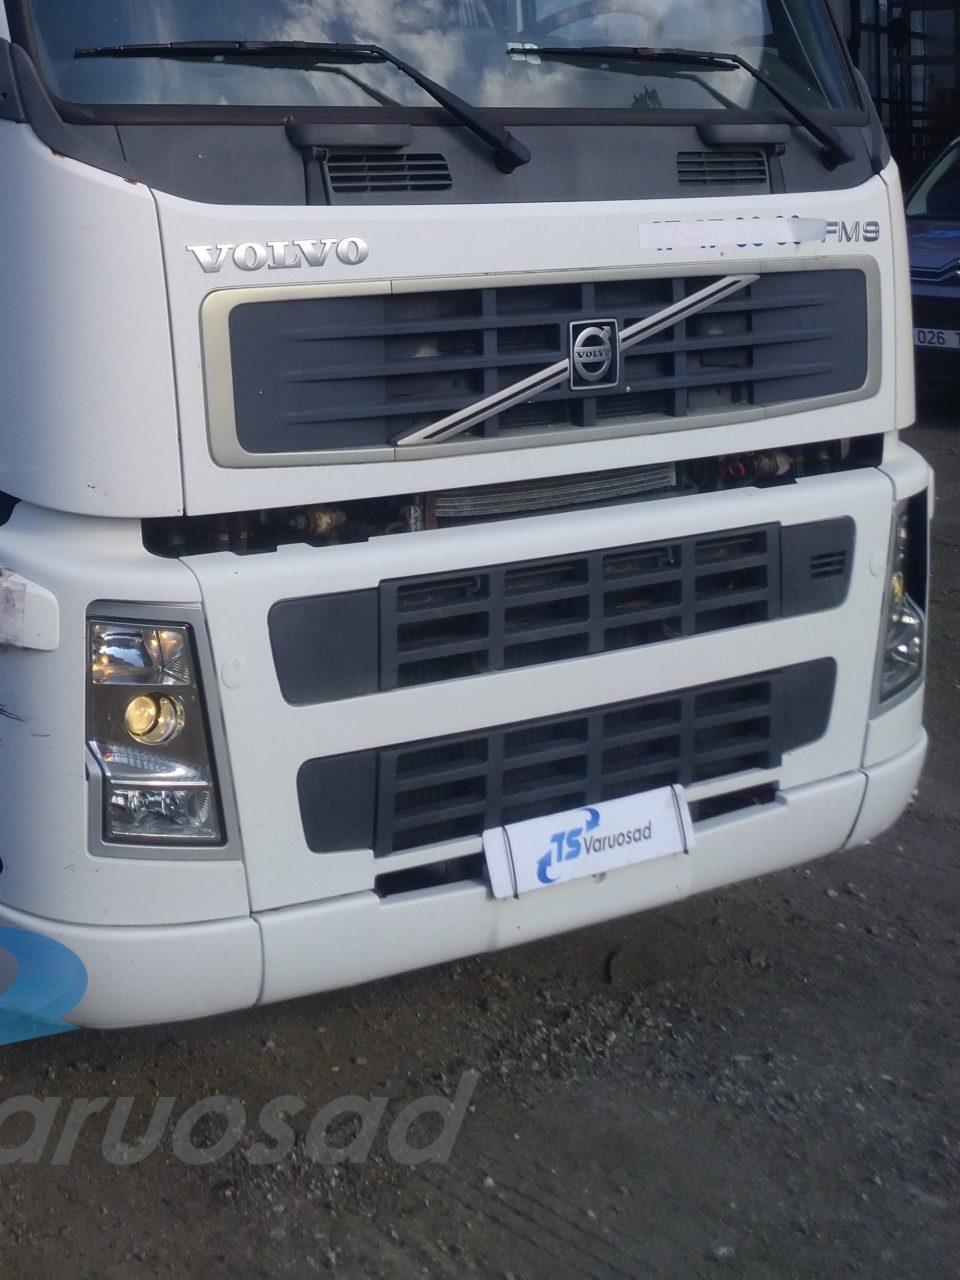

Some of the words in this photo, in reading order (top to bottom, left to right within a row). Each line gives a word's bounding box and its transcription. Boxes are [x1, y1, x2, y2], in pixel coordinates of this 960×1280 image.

[186, 237, 369, 273] VOLVO
[917, 330, 946, 346] 026
[575, 348, 612, 360] VOLVO
[583, 820, 652, 855] Varuosad
